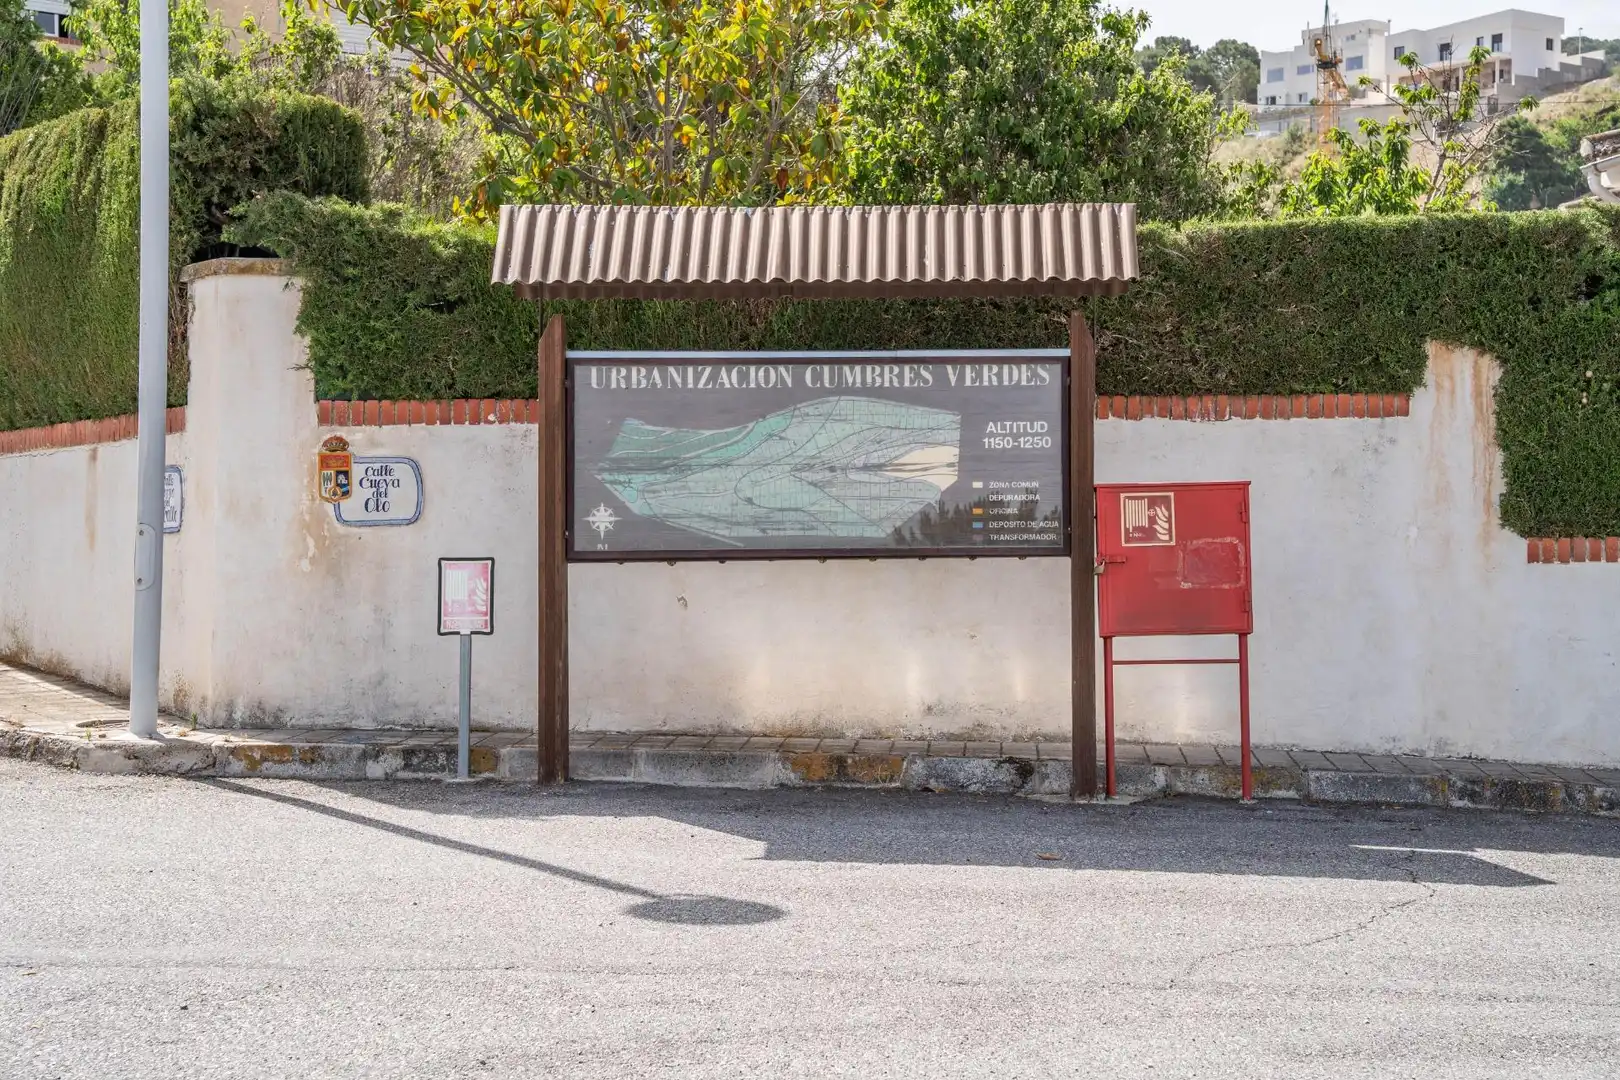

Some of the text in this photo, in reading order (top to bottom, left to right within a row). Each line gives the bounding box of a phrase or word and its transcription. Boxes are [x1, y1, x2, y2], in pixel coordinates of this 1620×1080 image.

[590, 363, 1051, 389] URBANIZACION CUMBRES VERDES
[986, 421, 1048, 434] ALTITUD
[982, 436, 1052, 449] 1150-1250
[365, 465, 395, 476] Calle
[359, 477, 400, 489] Cueva
[988, 481, 1010, 489] ZONA
[372, 487, 388, 498] del
[989, 494, 1041, 502] DEPURADORA
[989, 520, 1059, 528] DEPOSITO DE AGUA
[989, 533, 1057, 541] TRANSFORMADOR
